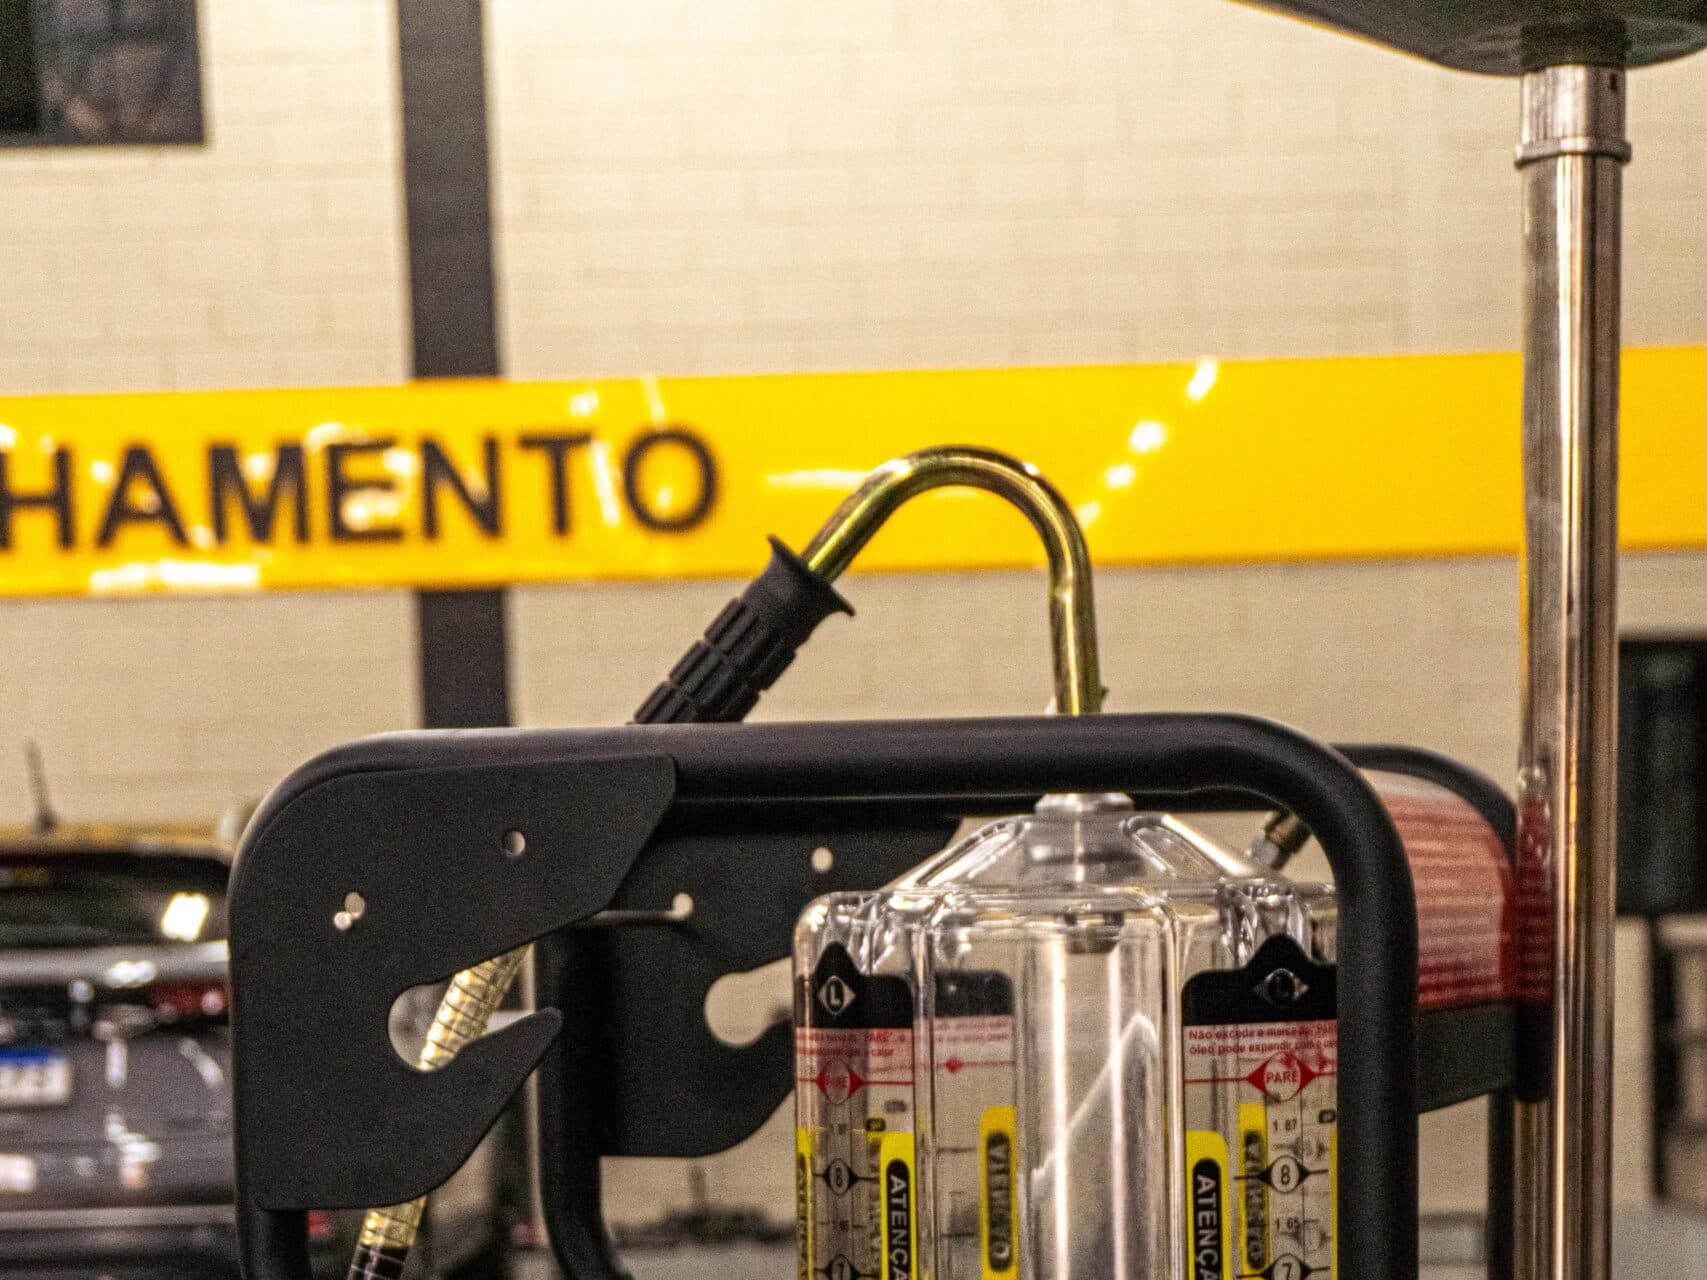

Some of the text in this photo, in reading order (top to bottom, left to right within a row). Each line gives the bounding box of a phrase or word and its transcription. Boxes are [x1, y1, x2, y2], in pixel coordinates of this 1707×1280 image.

[1266, 1070, 1298, 1084] PARE
[835, 1167, 843, 1188] 8
[1280, 1164, 1291, 1190] 8
